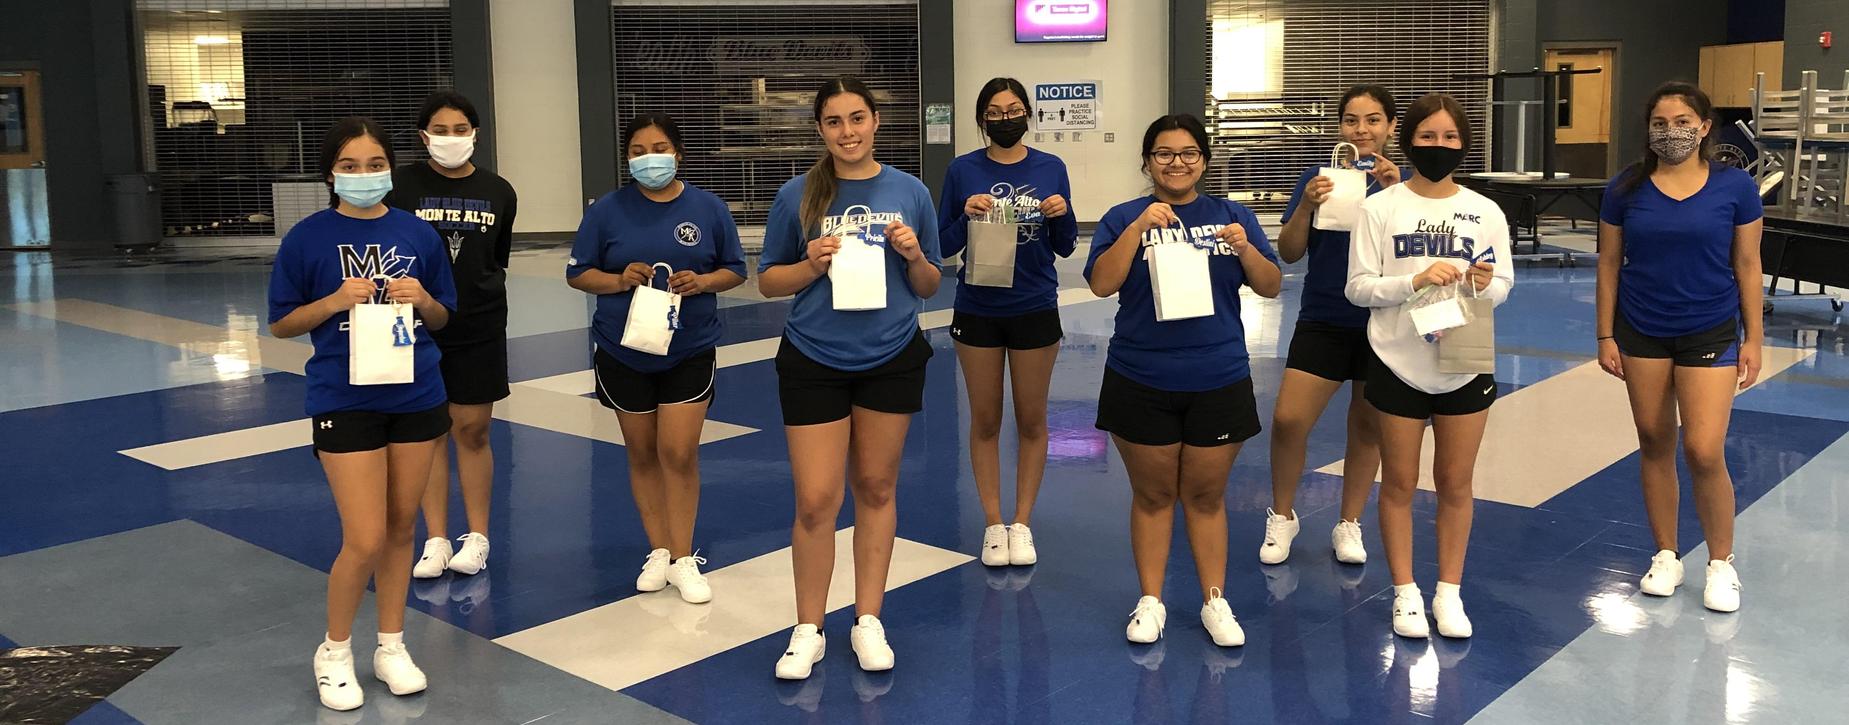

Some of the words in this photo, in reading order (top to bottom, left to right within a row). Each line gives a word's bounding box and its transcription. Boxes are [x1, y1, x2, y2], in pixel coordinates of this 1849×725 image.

[723, 40, 775, 62] Blue
[782, 39, 854, 61] Devils
[1040, 86, 1093, 98] NOTICE
[1014, 195, 1041, 207] Alto
[415, 208, 461, 222] MONTE
[463, 210, 495, 226] ALTO
[1414, 219, 1458, 239] Lady
[1392, 232, 1475, 260] DEVILS
